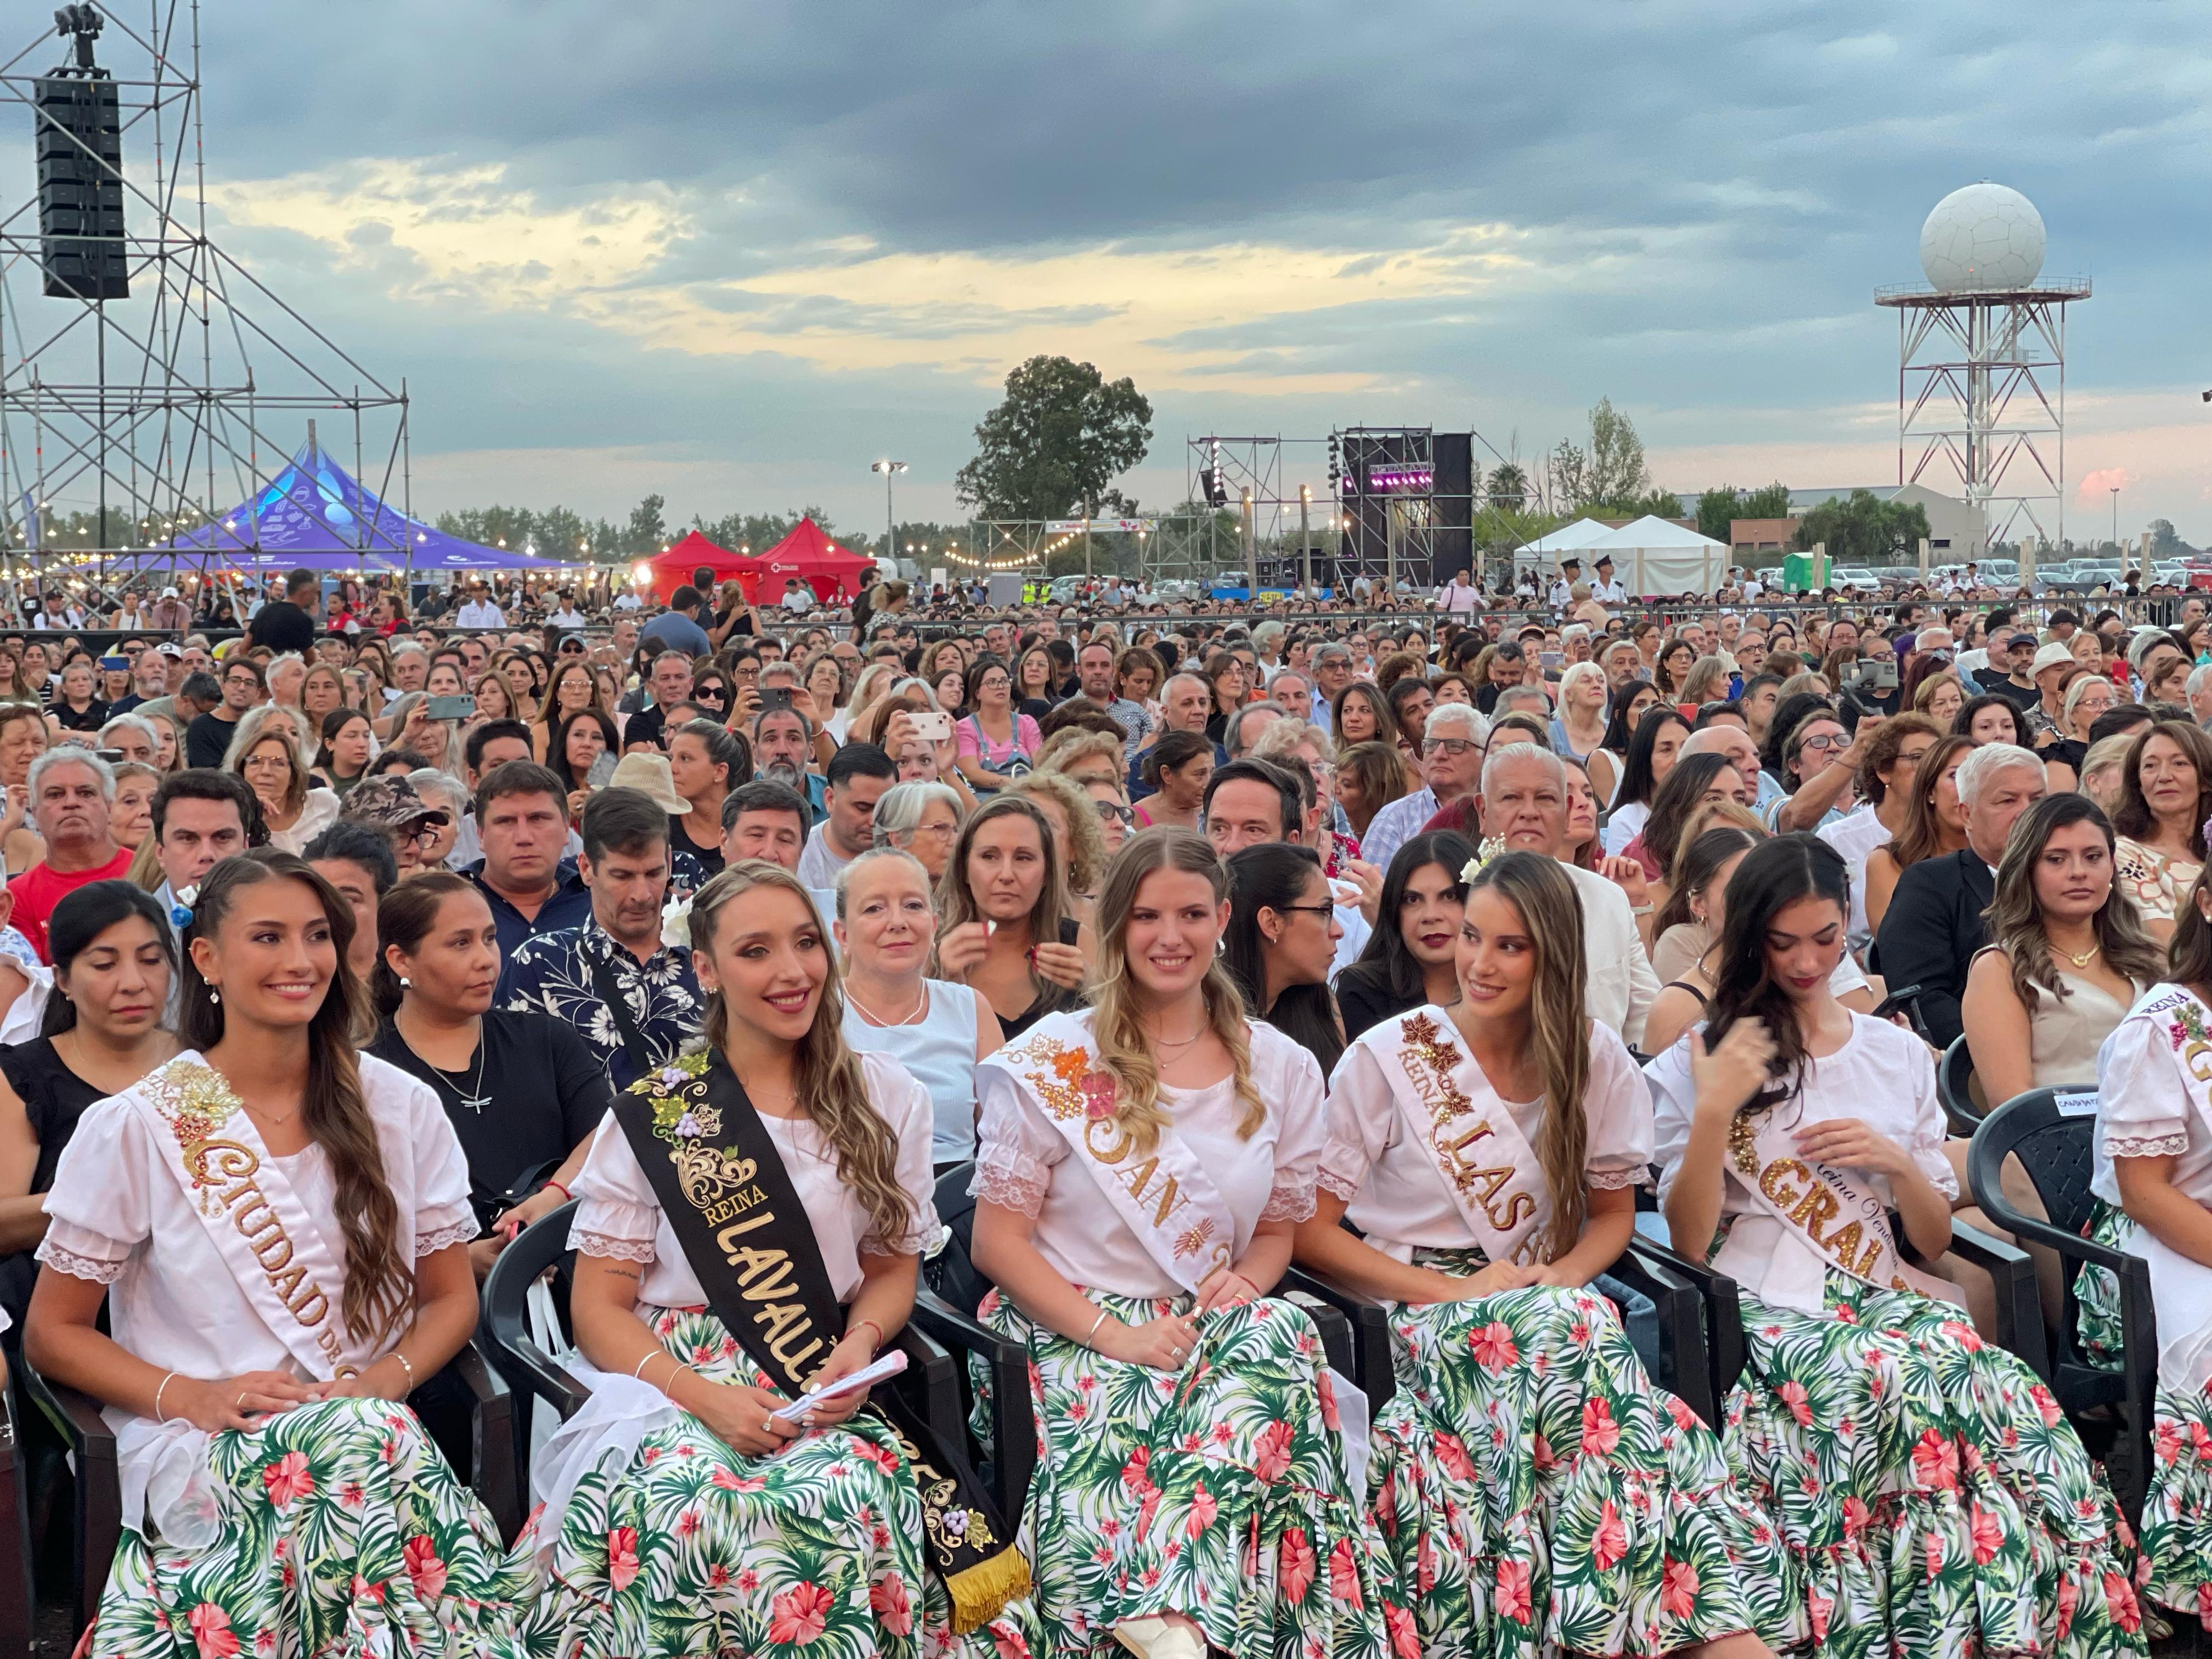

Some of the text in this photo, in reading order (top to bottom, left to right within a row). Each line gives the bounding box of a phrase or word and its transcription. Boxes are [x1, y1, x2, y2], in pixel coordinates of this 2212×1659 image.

[2140, 991, 2189, 1014] REINA
[1397, 1049, 1448, 1118] REINA
[702, 1184, 769, 1228] REINA
[1083, 1117, 1191, 1229] SAN
[1445, 1120, 1537, 1231] LAS
[183, 1138, 342, 1365] CIUDAD DE
